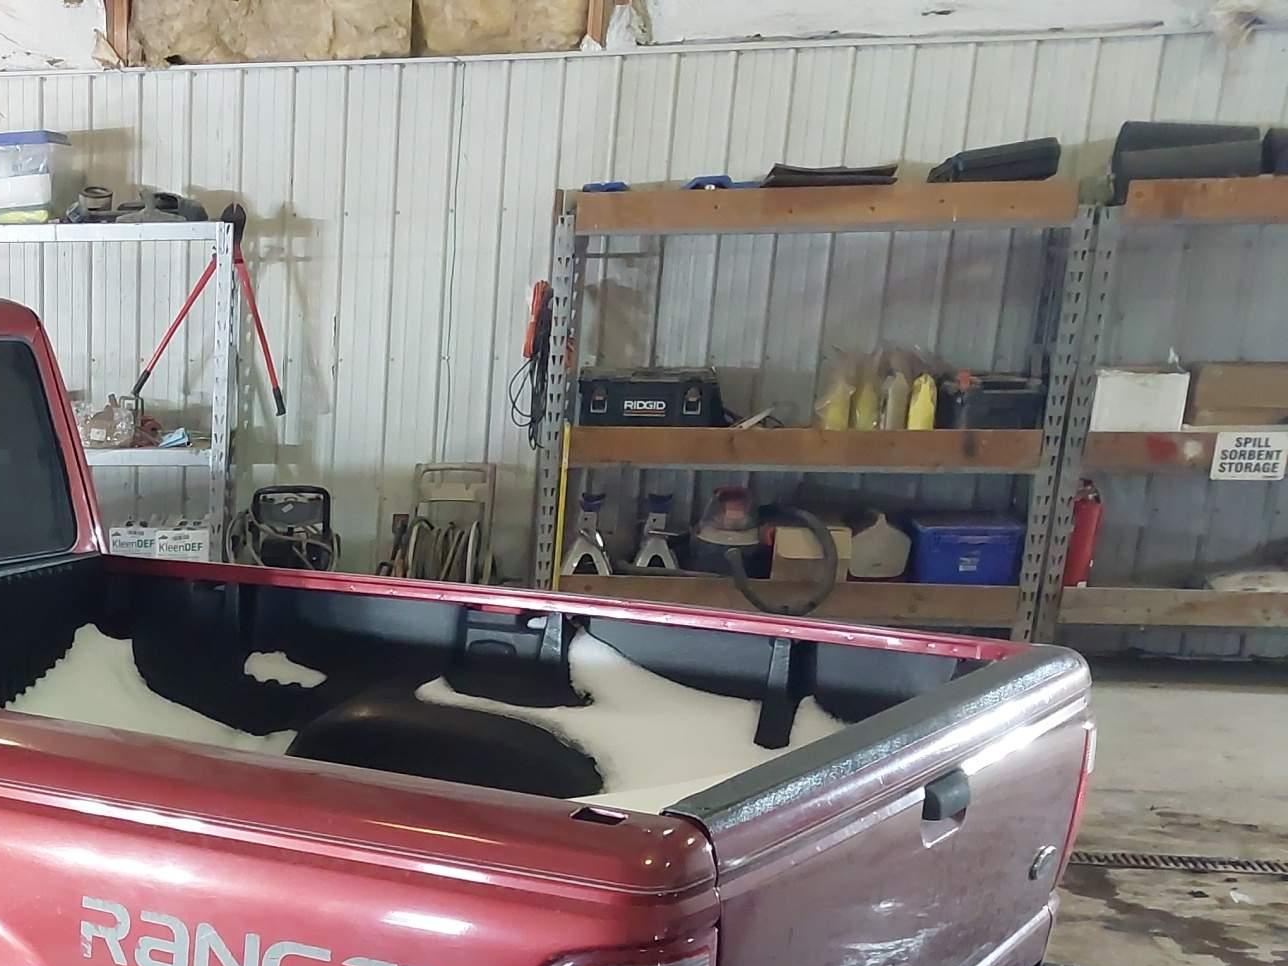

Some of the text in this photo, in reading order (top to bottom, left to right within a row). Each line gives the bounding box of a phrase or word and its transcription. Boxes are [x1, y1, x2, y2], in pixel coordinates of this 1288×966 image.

[624, 400, 666, 410] RIDGID
[1235, 437, 1271, 448] SPILL
[1220, 449, 1282, 460] SORBENT
[1218, 462, 1279, 473] STORAGE
[158, 541, 203, 553] KleenDEF
